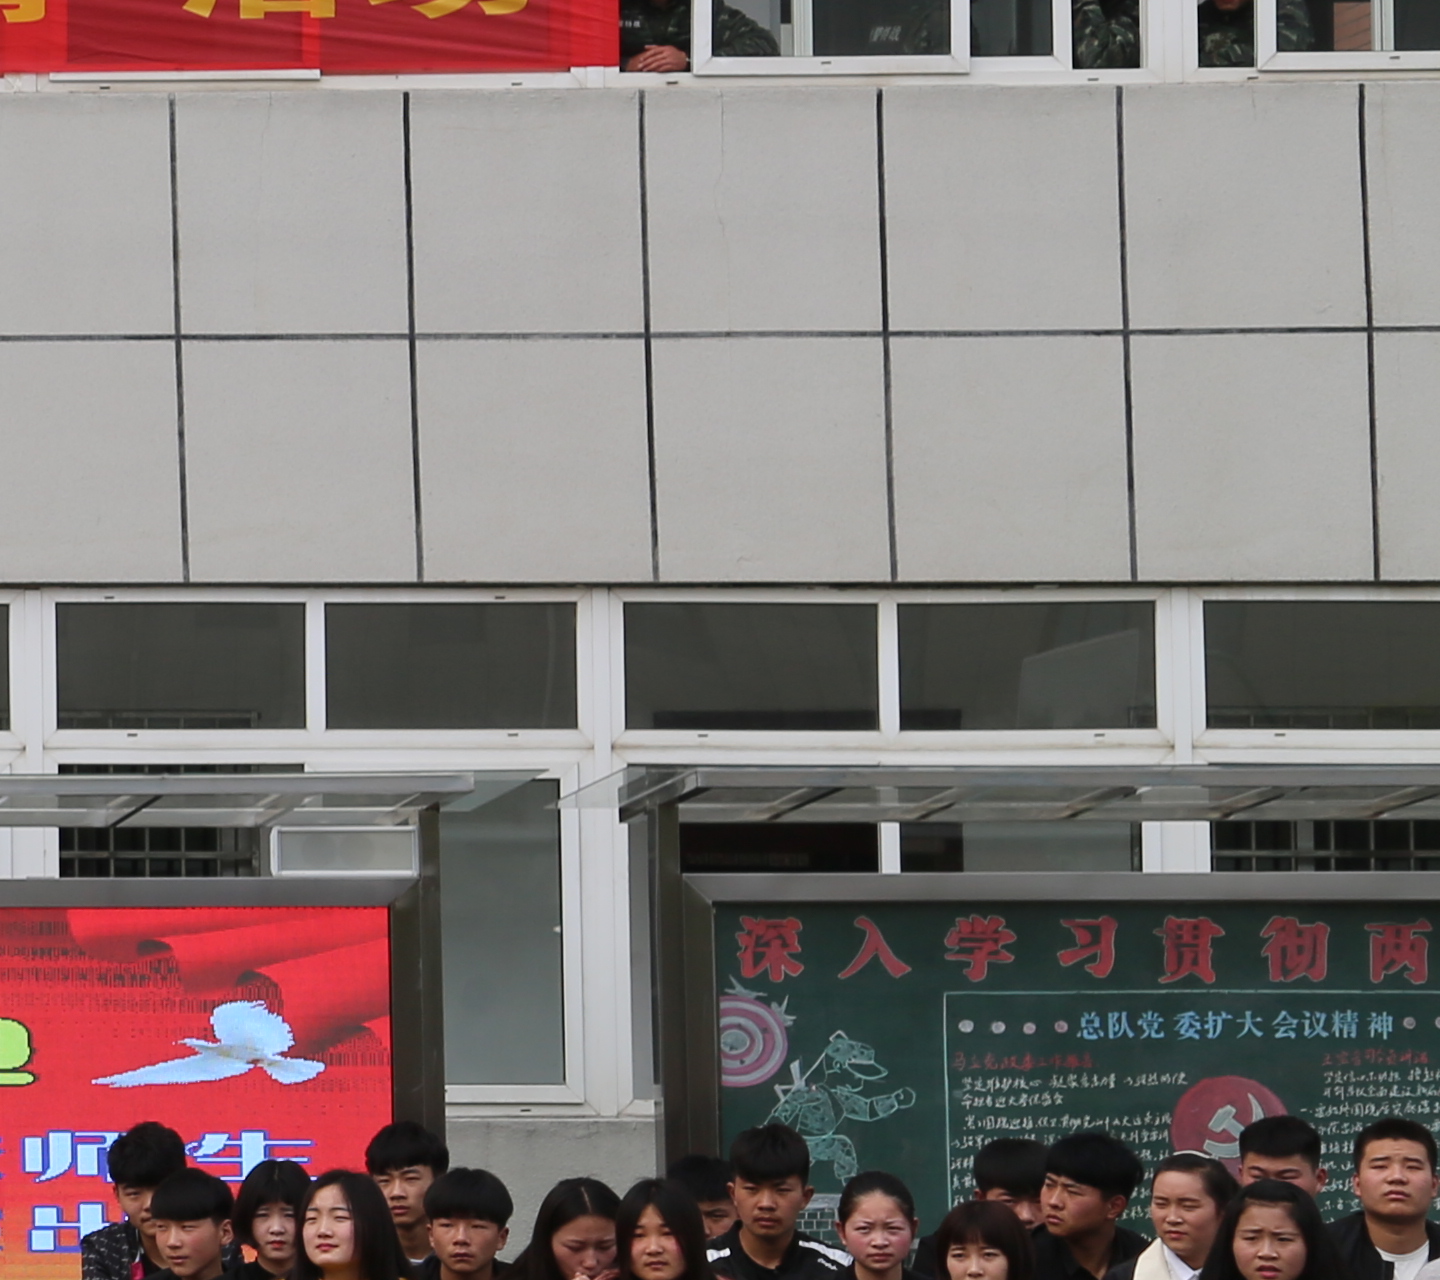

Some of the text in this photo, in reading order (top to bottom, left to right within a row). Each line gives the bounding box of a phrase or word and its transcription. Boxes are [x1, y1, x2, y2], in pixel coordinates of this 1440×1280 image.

[737, 916, 1433, 984] 深入学习贯彻两
[1076, 1009, 1394, 1041] 总队党委扩大会议精神
